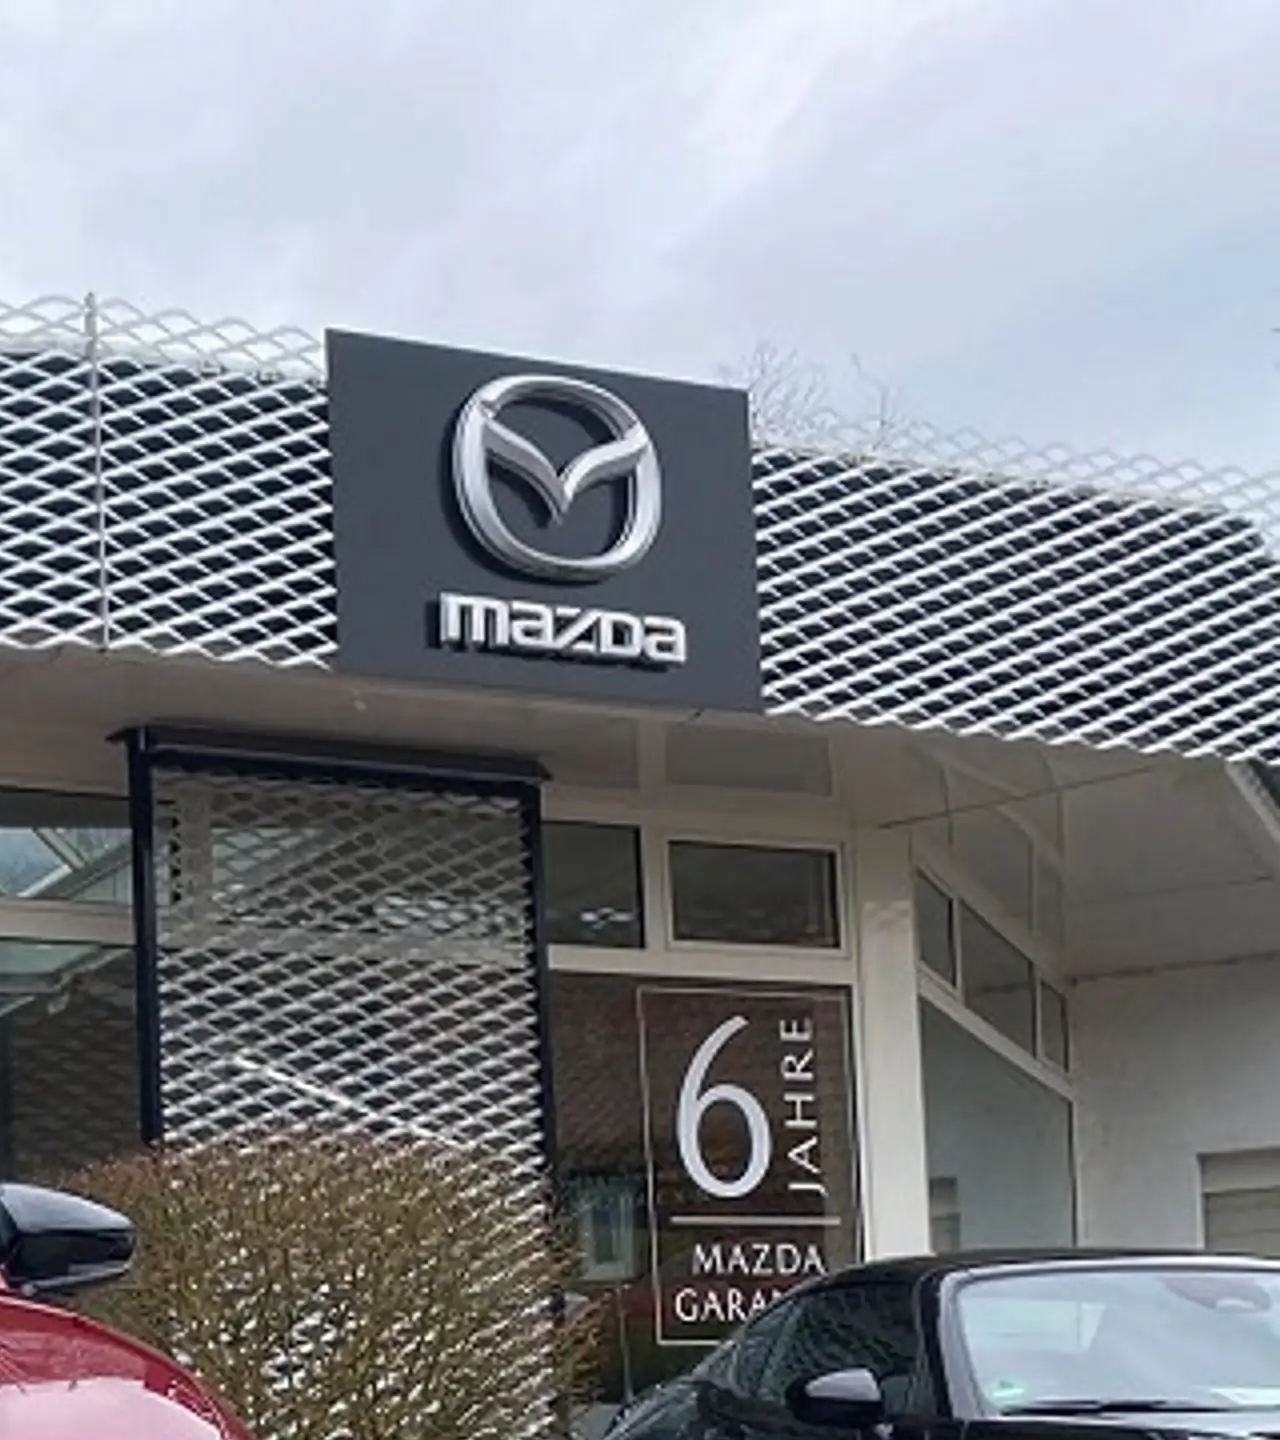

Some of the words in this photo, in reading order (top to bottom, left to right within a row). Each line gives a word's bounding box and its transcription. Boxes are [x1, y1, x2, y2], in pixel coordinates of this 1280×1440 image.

[677, 1015, 772, 1197] 6
[780, 1018, 828, 1197] JAHRE
[691, 1243, 827, 1276] MAZDA
